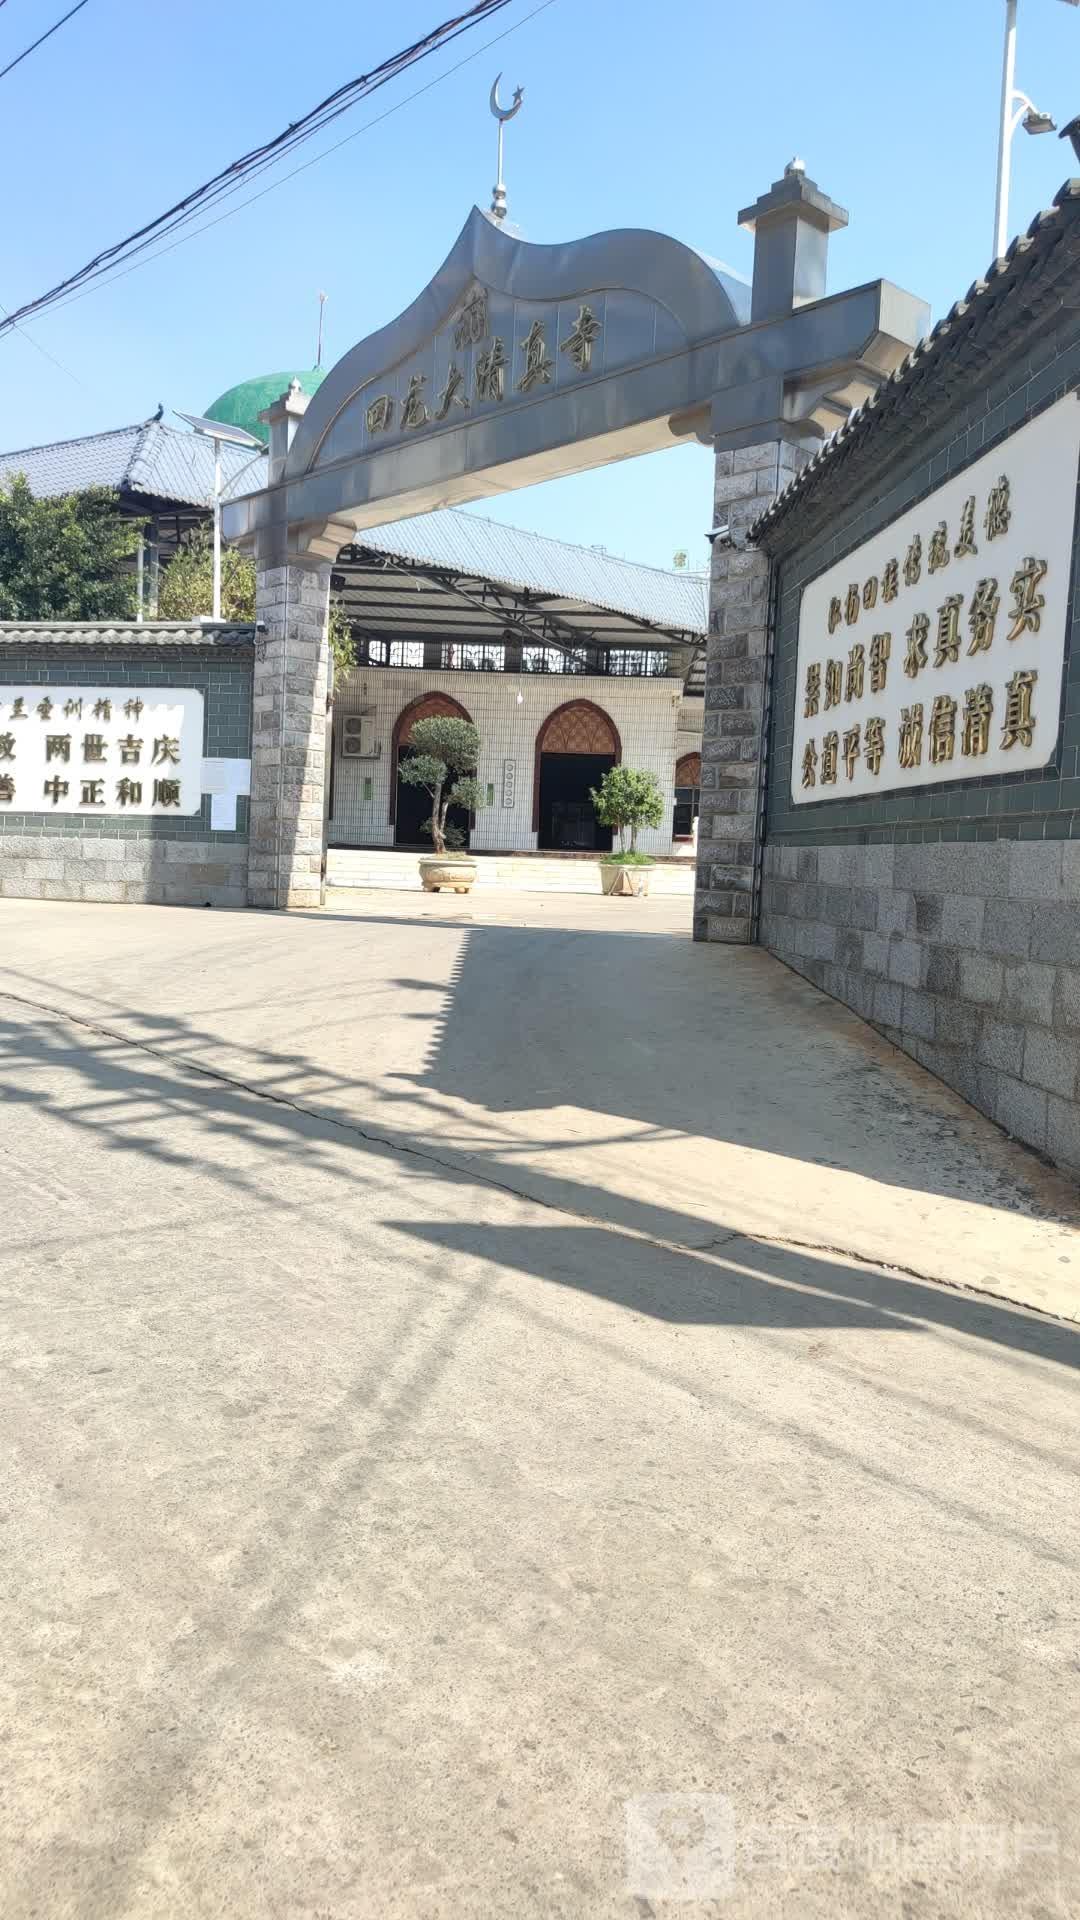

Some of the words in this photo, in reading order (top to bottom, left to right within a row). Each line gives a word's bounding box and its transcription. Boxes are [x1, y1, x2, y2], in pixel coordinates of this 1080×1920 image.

[903, 556, 1048, 678] 求真务实
[45, 733, 181, 765] 两世吉庆
[801, 716, 886, 789] 公道平等
[897, 669, 1038, 769] 诚信清真
[44, 775, 181, 808] 中正和顺
